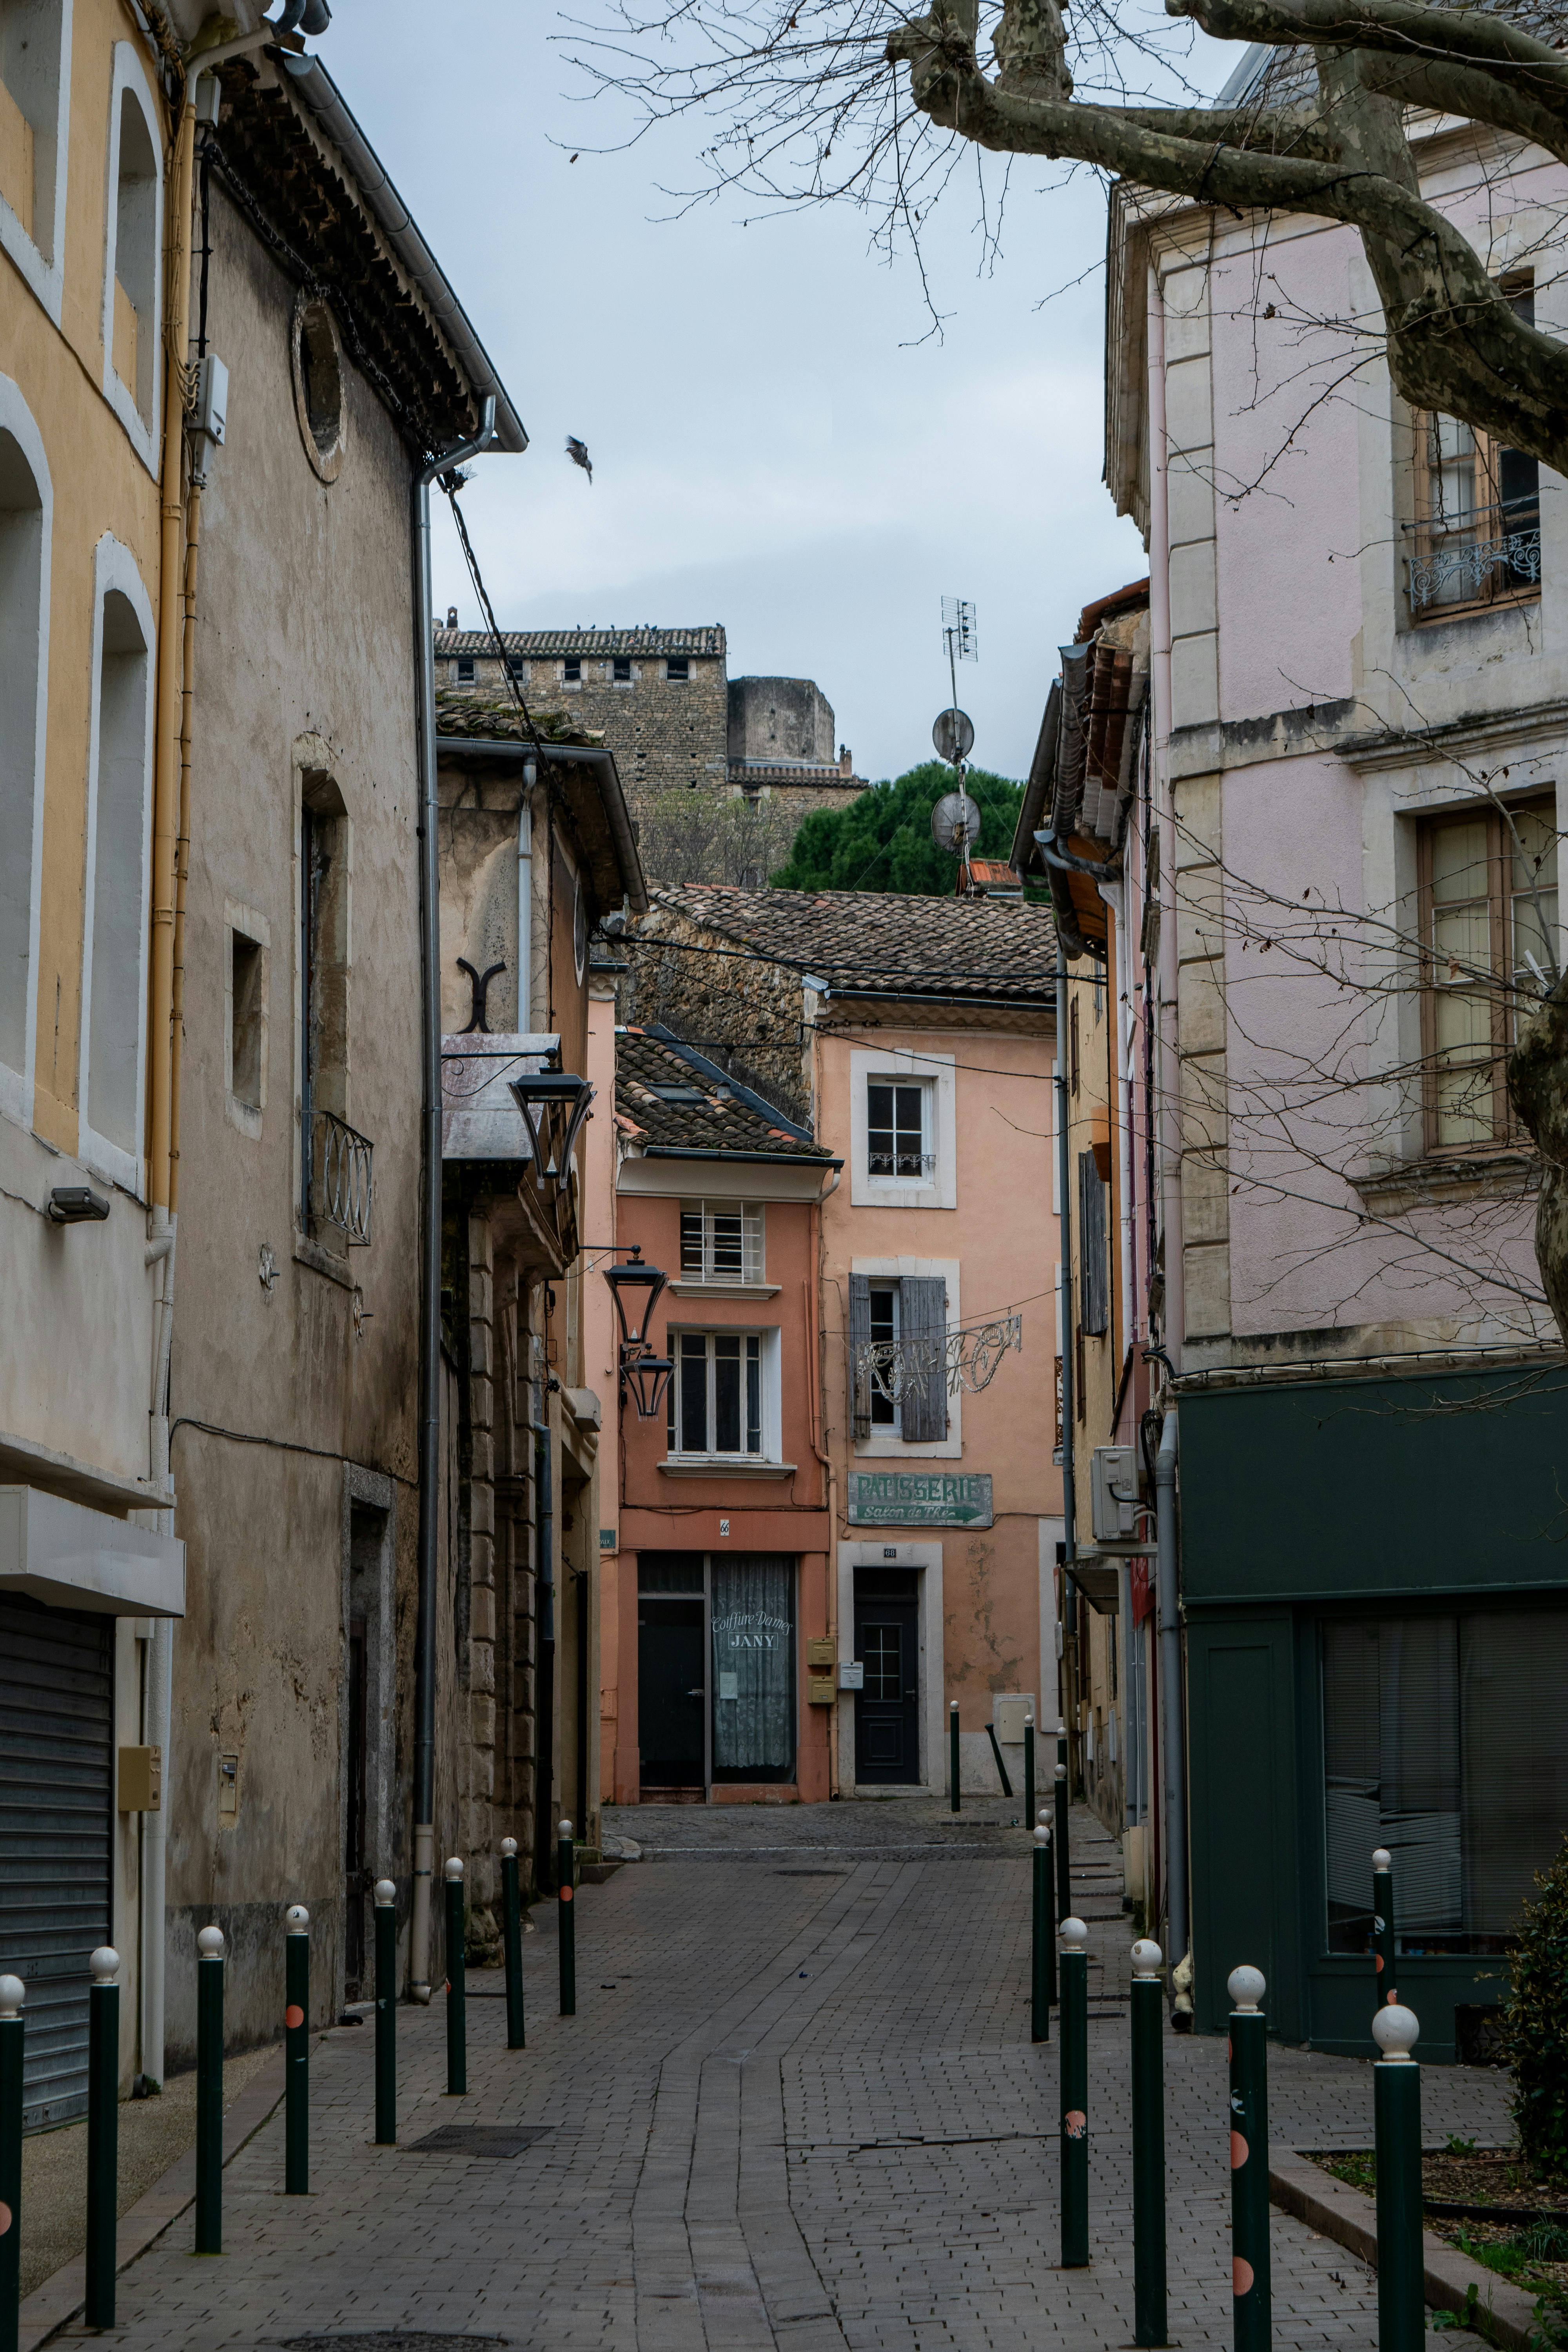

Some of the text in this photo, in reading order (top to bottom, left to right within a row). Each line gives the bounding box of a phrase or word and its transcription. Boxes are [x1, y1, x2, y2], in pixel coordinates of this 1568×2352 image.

[857, 1476, 981, 1502] PATISSERIE
[864, 1505, 955, 1518] Salon de Thé
[720, 1523, 729, 1532] 66
[731, 1635, 774, 1647] JANY
